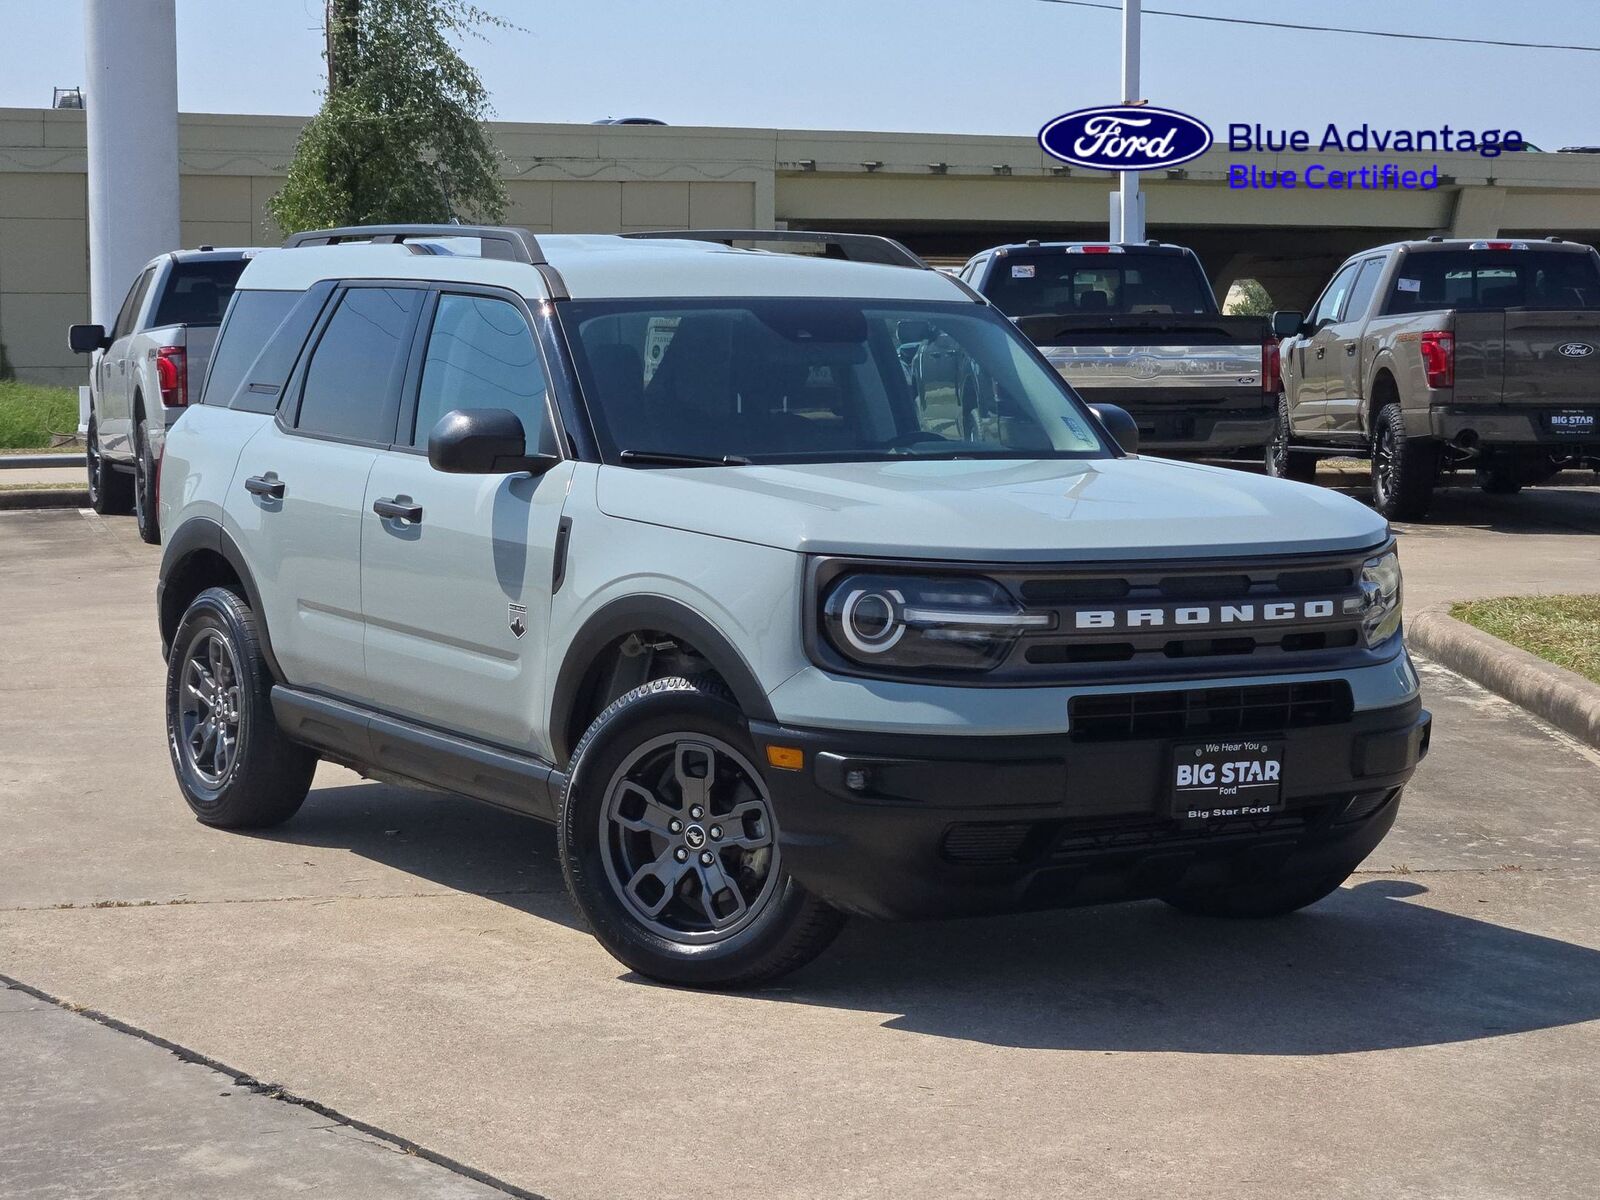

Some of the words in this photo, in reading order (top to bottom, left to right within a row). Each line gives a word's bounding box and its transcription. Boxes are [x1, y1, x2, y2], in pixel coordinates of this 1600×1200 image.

[1551, 416, 1568, 424] BIG
[1569, 416, 1594, 424] STAR
[1075, 600, 1334, 628] BRONCO
[1205, 744, 1219, 753] We
[1222, 743, 1241, 752] Hear
[1244, 741, 1259, 750] You
[1176, 763, 1216, 786] BIG
[1221, 760, 1281, 783] STAR
[1219, 786, 1237, 795] Ford
[1188, 810, 1209, 819] Big
[1213, 808, 1239, 817] Star
[1242, 805, 1270, 814] Ford
